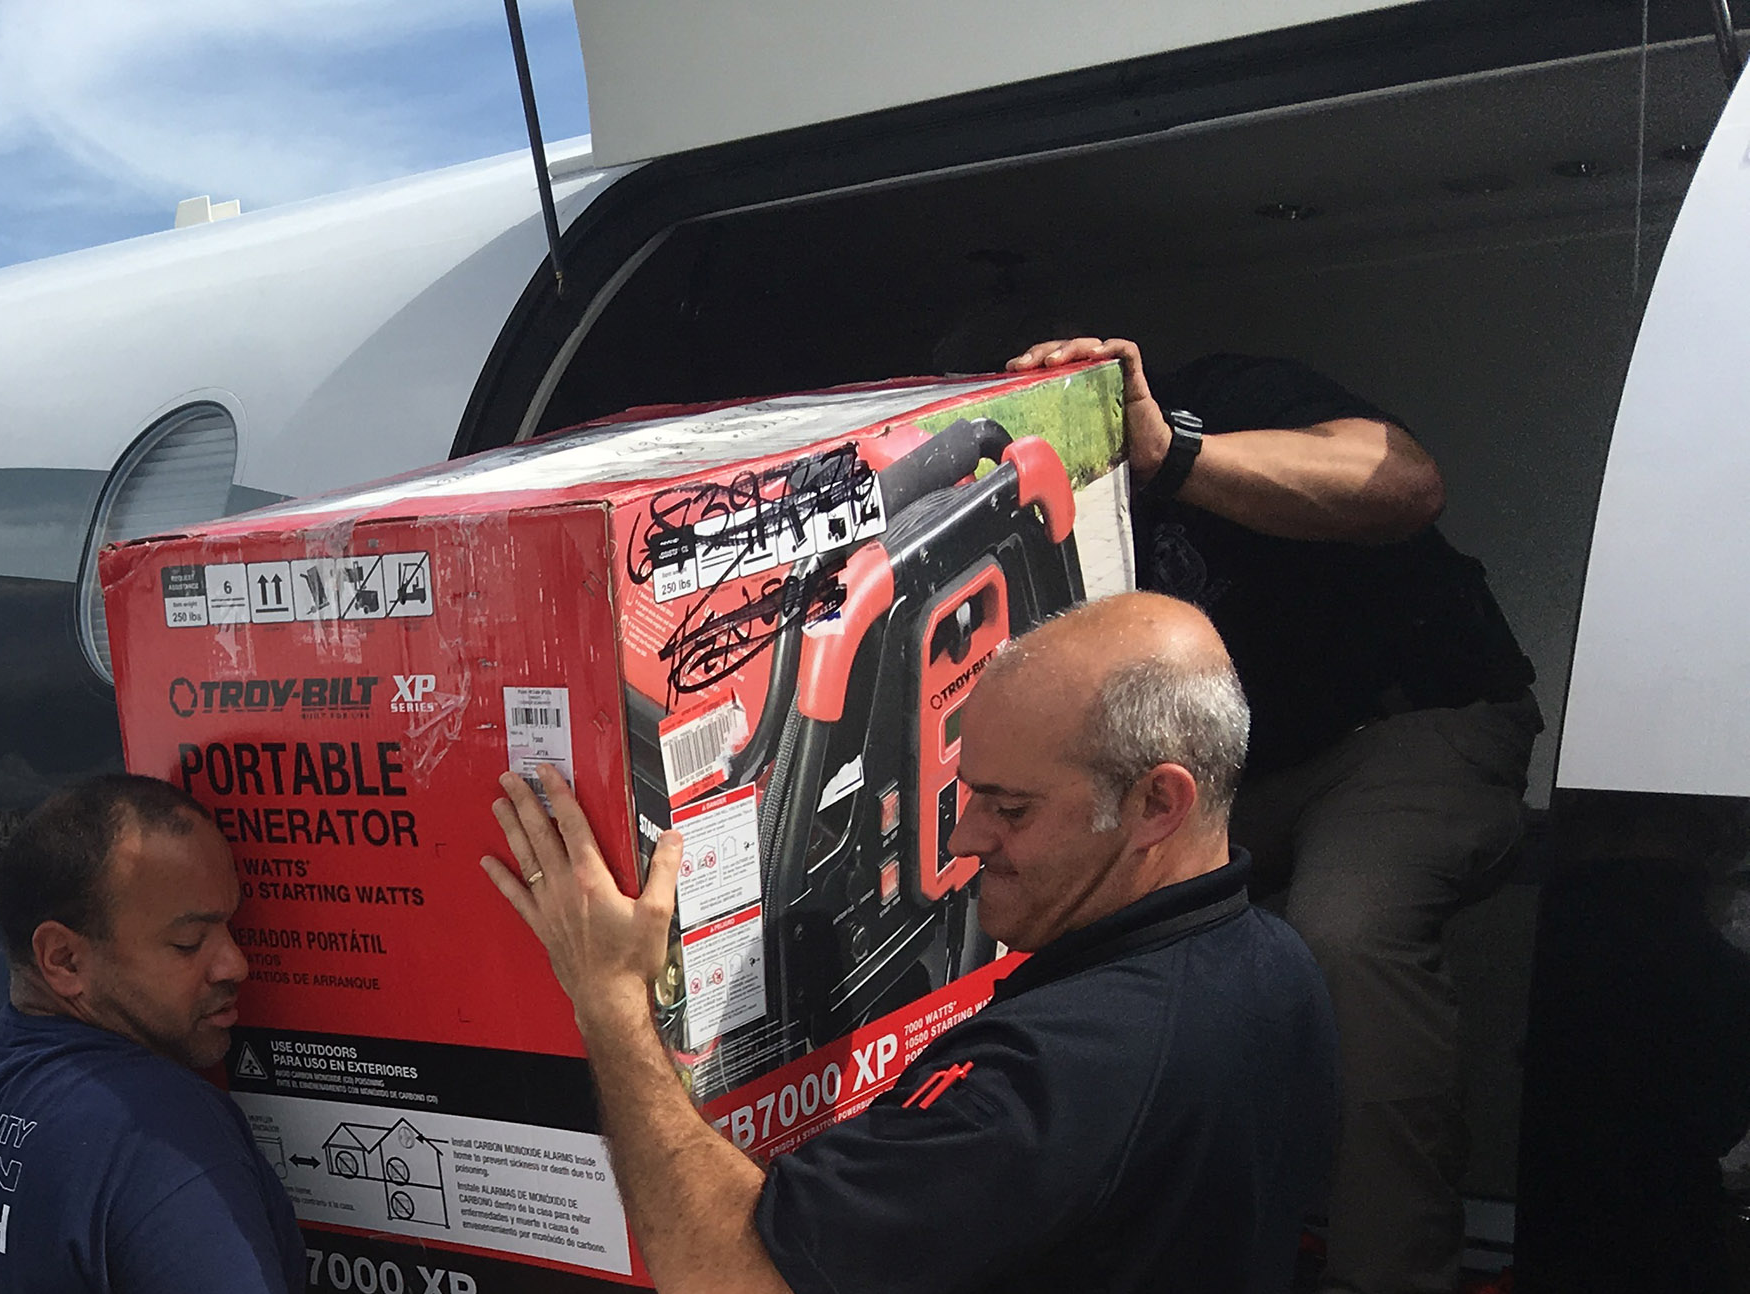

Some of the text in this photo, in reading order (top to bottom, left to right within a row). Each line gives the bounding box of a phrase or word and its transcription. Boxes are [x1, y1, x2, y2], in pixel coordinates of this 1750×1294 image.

[223, 580, 233, 594] 6
[172, 612, 187, 622] 250
[200, 675, 435, 708] TROY-BILT XP
[391, 703, 434, 712] SERIES
[179, 742, 407, 796] PORTABLE
[213, 808, 419, 847] ENERATOR
[258, 883, 424, 906] STARTING WATTS
[306, 928, 387, 955] PORTÁTIL
[904, 996, 994, 1050] 10500 STARTING WAT
[904, 1020, 923, 1036] 7000
[270, 1040, 357, 1060] USE OUTDOORS
[852, 1033, 898, 1093] XP
[273, 1053, 301, 1068] PARA
[302, 1055, 328, 1071] USO
[330, 1058, 345, 1072] EN
[347, 1059, 418, 1079] EXTERIORES
